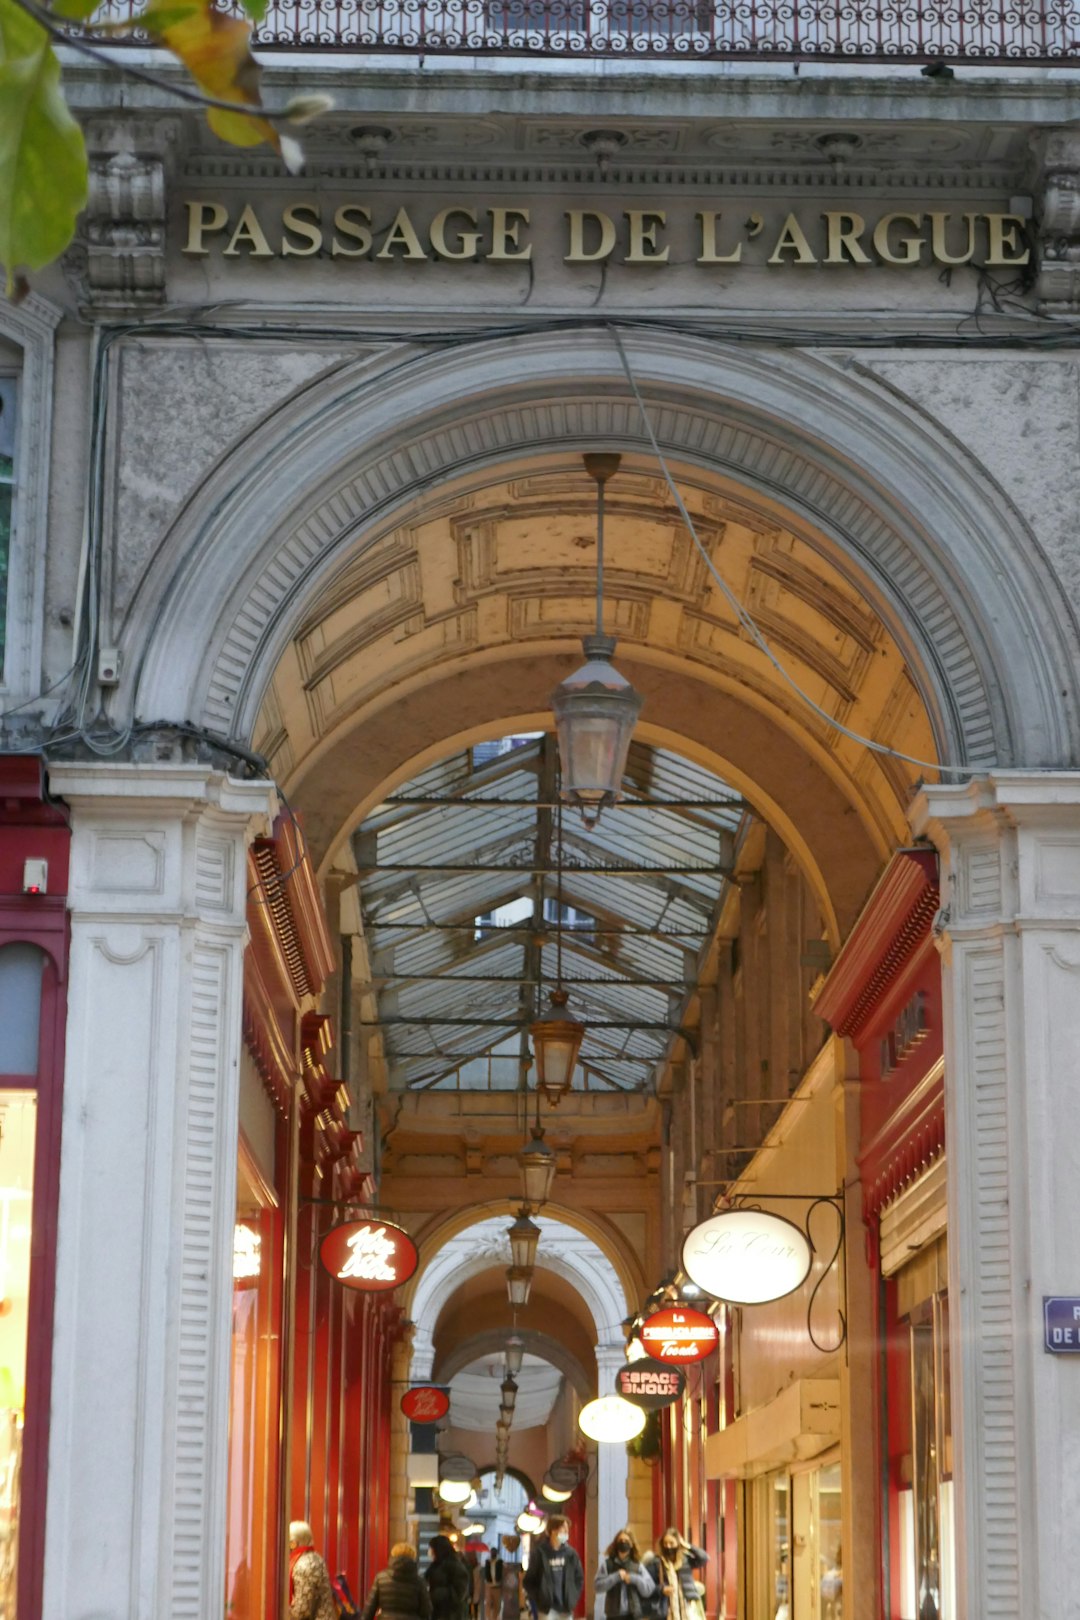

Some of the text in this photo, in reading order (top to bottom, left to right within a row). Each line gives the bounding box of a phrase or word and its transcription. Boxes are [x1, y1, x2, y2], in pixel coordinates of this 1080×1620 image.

[182, 201, 1032, 267] PASSAGE DE L'ARGUE
[1053, 1327, 1073, 1344] DE
[620, 1371, 679, 1385] ESPACE
[622, 1383, 678, 1396] BIJOUX
